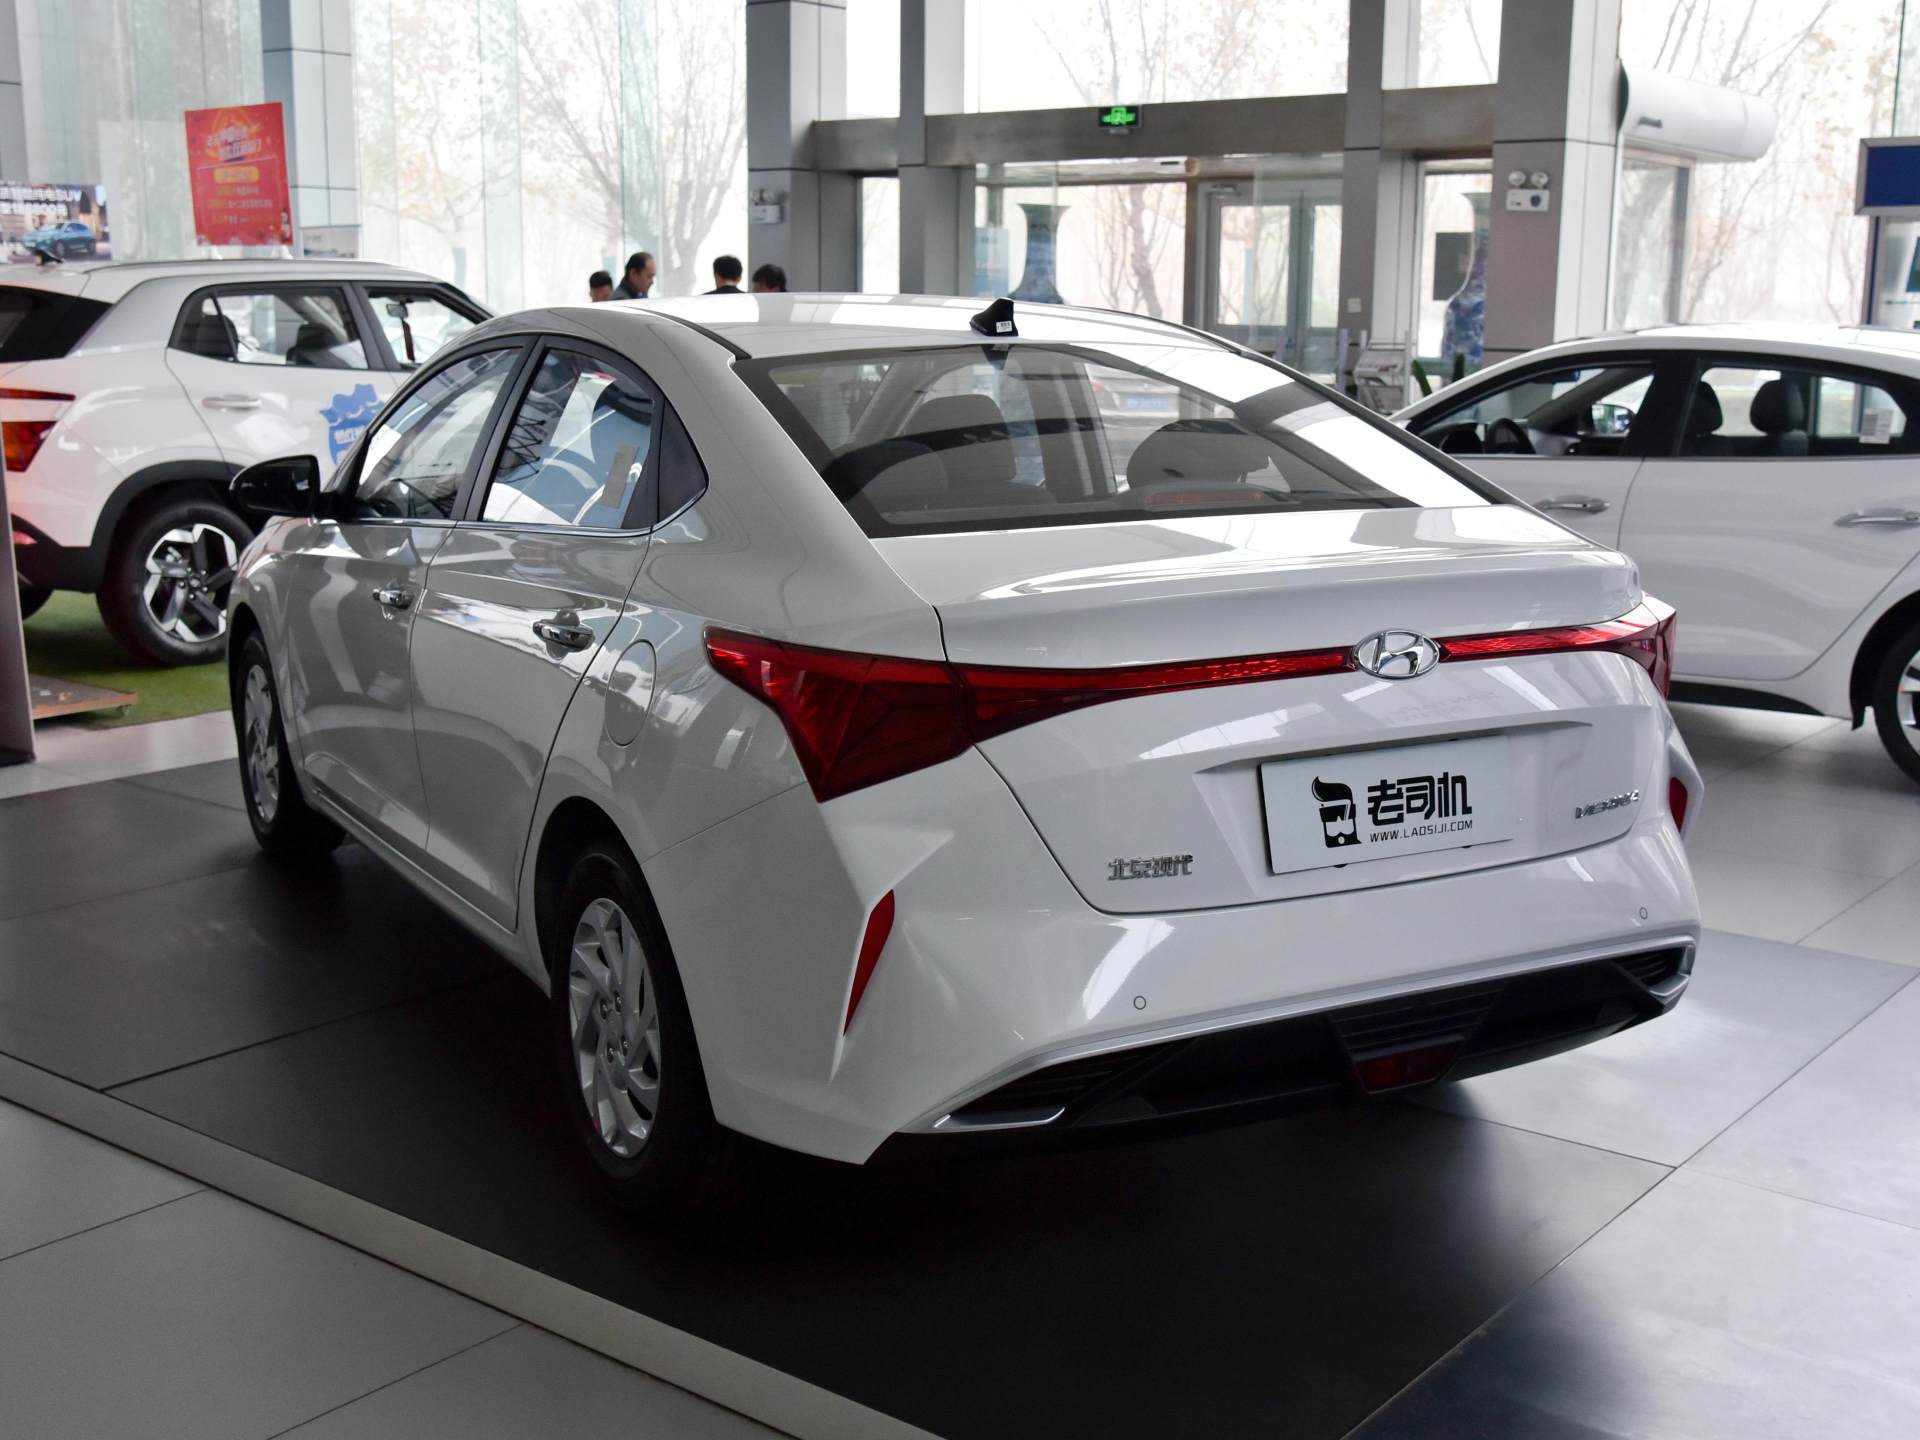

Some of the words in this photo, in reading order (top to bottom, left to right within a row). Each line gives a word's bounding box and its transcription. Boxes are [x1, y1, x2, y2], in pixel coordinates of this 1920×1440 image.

[1367, 771, 1473, 827] 老司机
[1369, 819, 1474, 843] WWW.LAOSIJI.COM
[1107, 854, 1193, 881] 北京现代
